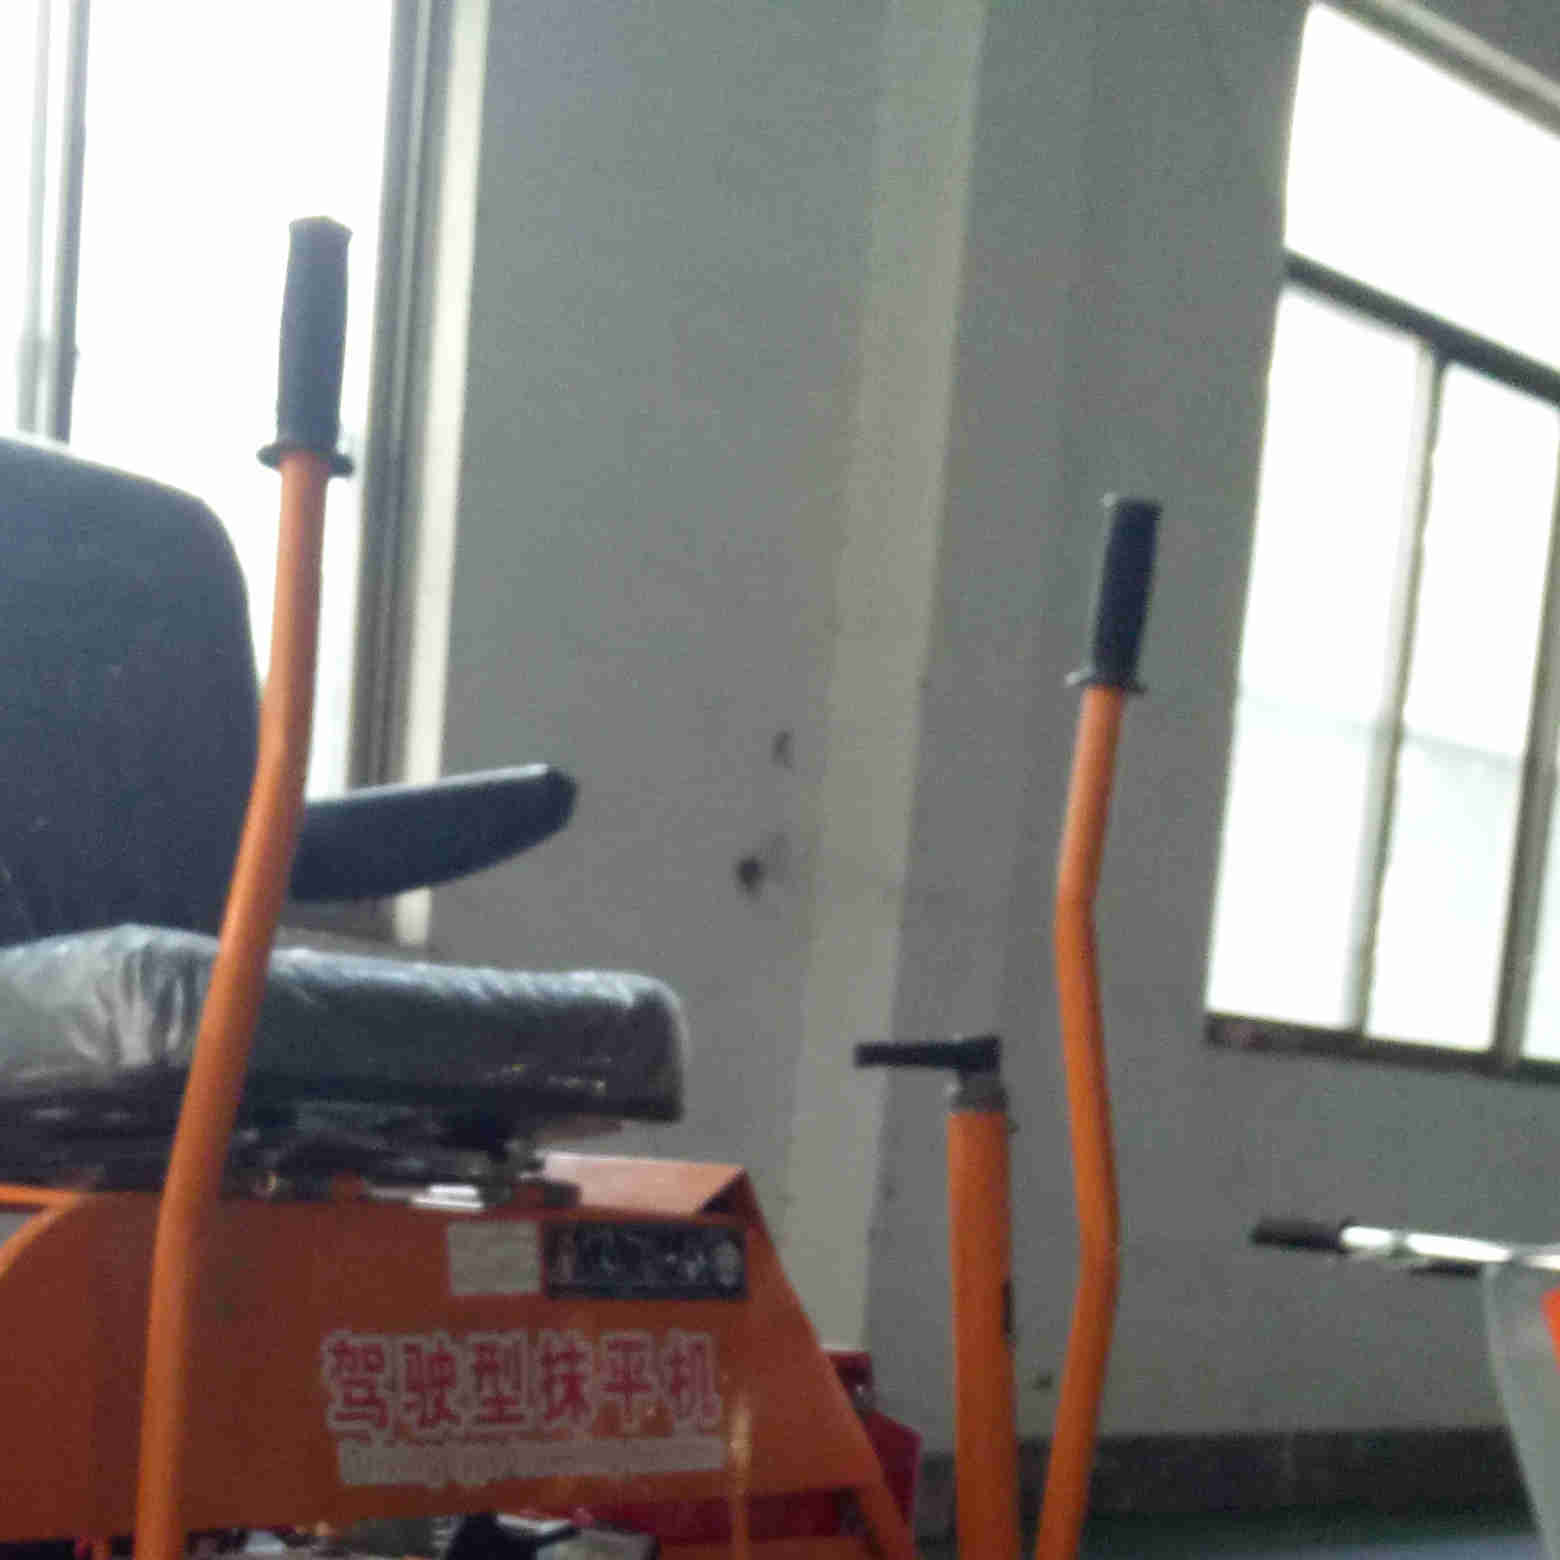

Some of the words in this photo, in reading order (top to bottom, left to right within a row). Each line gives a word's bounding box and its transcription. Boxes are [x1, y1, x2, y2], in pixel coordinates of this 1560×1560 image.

[324, 1331, 721, 1437] 驾驶型抹平机
